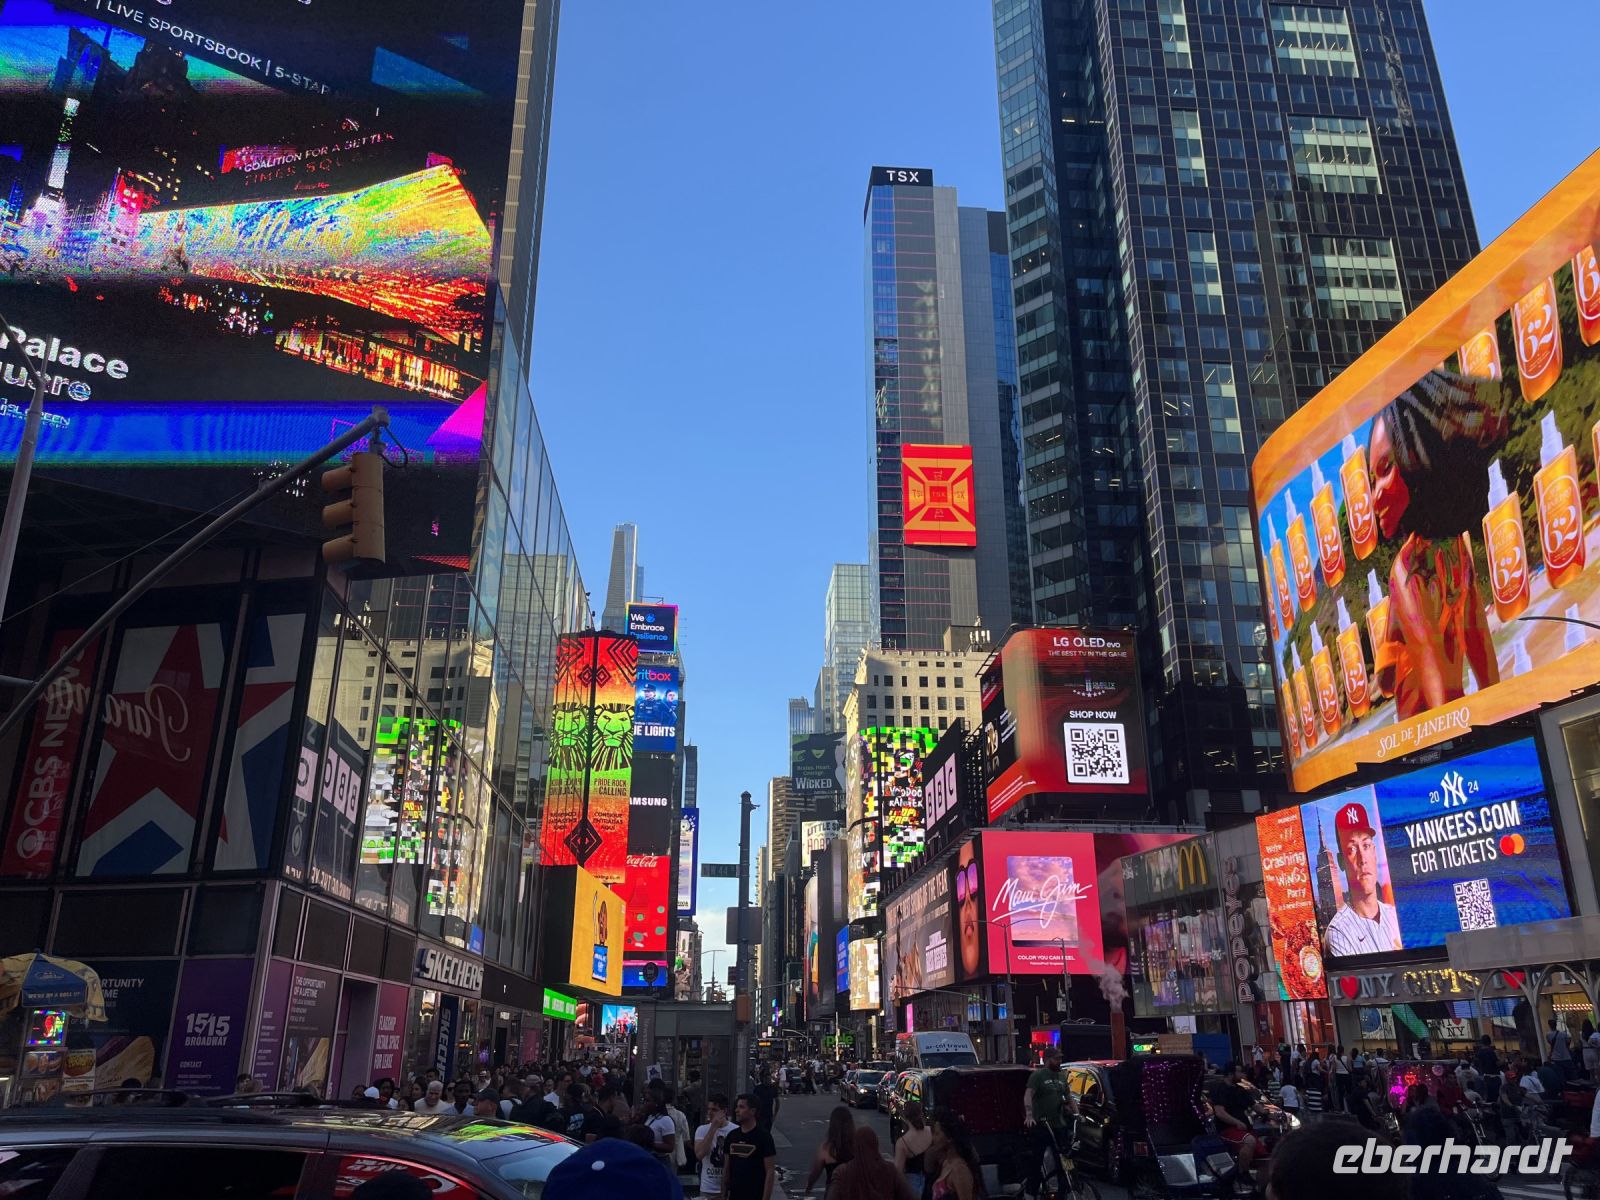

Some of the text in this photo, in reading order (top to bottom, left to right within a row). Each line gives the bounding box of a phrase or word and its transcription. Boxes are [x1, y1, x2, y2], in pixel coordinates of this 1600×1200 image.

[107, 1, 144, 23] LIVE
[149, 17, 262, 70] SPORTSBOOK
[305, 146, 329, 159] FOR
[886, 169, 920, 183] TSX
[630, 613, 645, 622] We
[630, 622, 665, 632] Embrace
[1053, 636, 1069, 647] LG
[1073, 637, 1106, 648] OLED
[1069, 710, 1117, 719] SHOP NOW
[644, 726, 676, 738] LIGHTS
[1377, 706, 1470, 758] SOL DE JANEIRO
[24, 754, 61, 827] CBS
[926, 767, 955, 818] BBC
[1429, 790, 1440, 805] 20
[1467, 780, 1479, 795] 24
[1405, 799, 1520, 850] YANKEES.COM
[1263, 851, 1306, 870] Crashing
[1410, 837, 1497, 875] FOR TICKETS
[992, 874, 1093, 929] Maui Jim
[1224, 856, 1255, 1004] POPEYES
[423, 949, 485, 991] SKECHERS
[1331, 976, 1342, 999] I
[186, 1012, 231, 1037] 1515
[1446, 1026, 1465, 1038] NY
[185, 1036, 228, 1047] BROADWAY
